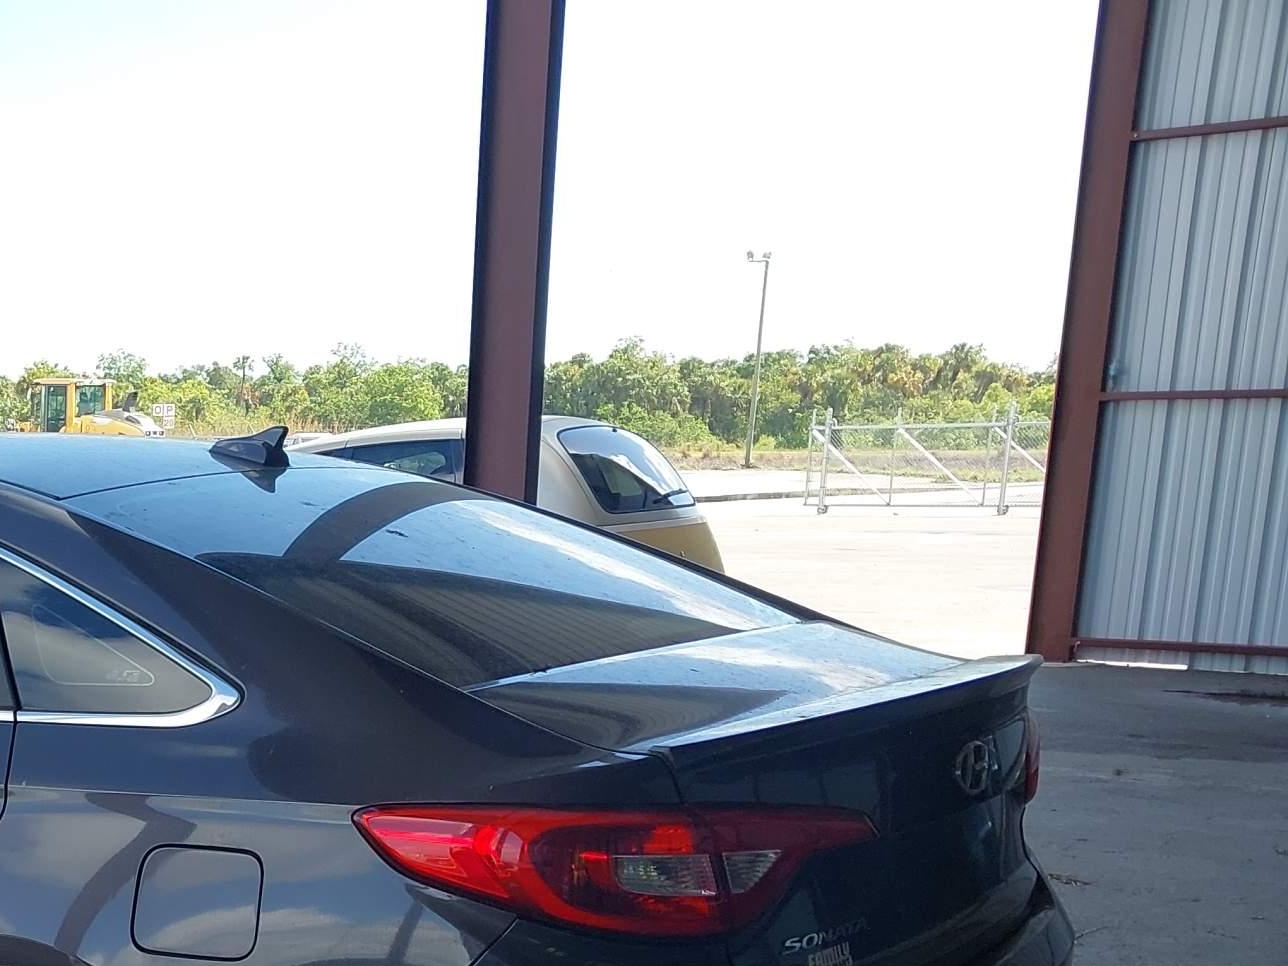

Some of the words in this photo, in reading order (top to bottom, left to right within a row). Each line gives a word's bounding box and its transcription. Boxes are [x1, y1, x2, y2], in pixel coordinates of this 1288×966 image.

[166, 405, 174, 415] P
[164, 419, 174, 427] 20
[783, 917, 868, 956] SONATA
